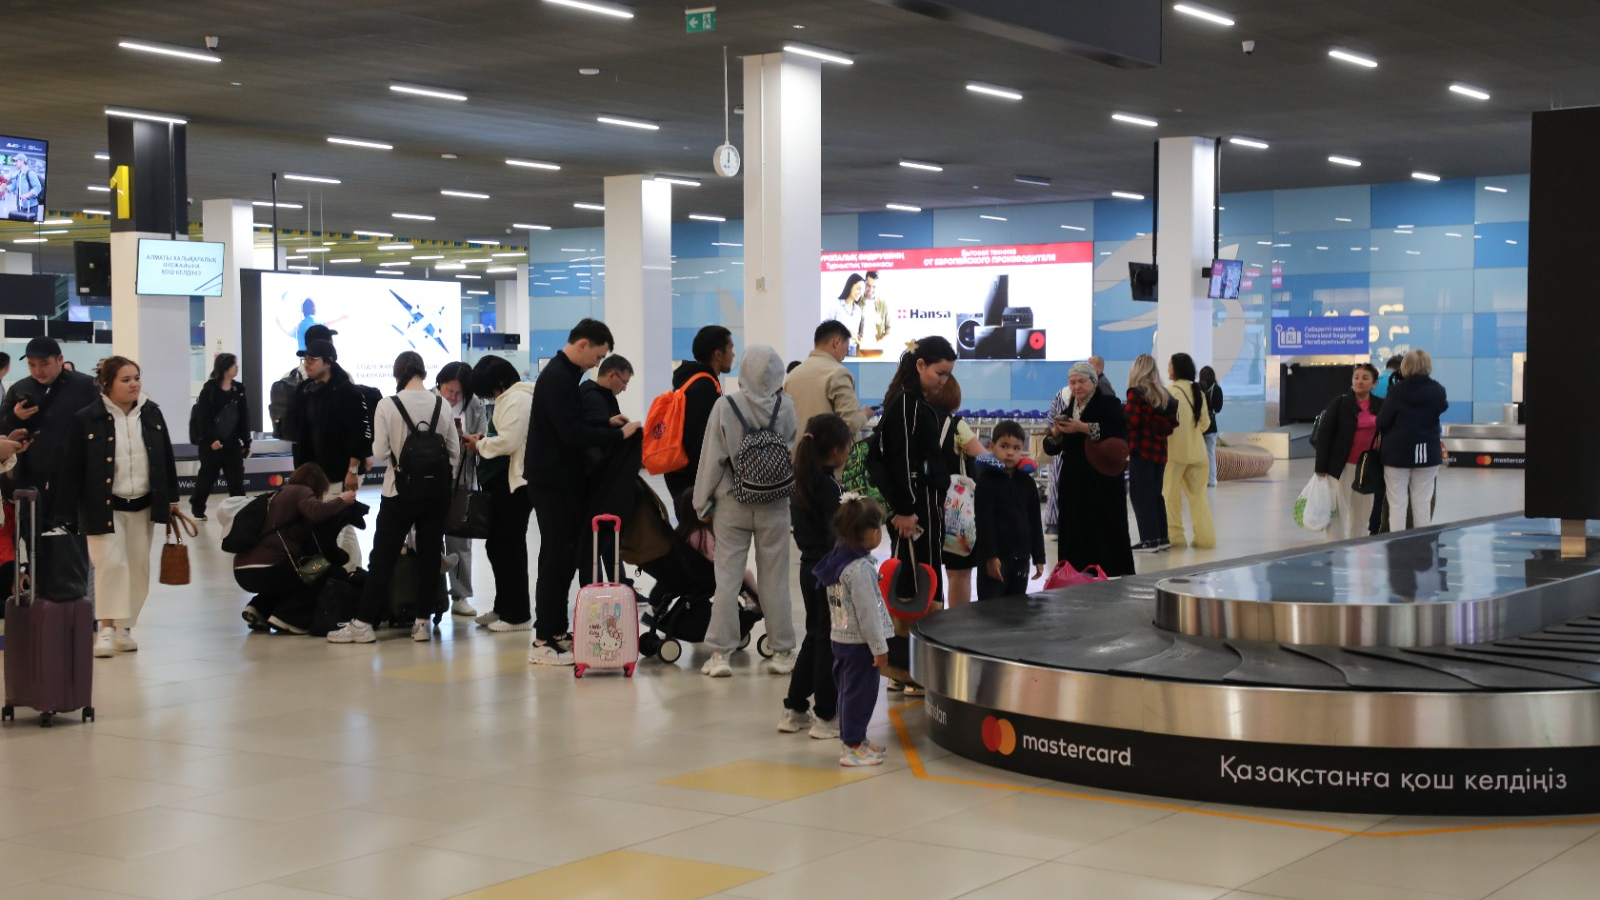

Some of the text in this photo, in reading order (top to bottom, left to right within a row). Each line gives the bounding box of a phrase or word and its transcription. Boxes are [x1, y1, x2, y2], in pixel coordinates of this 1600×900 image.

[110, 165, 129, 219] 1
[924, 254, 1056, 266] ОТ ЕВРОПЕЙСКОГО ПРОИЗВОДИТЕЛЯ
[961, 249, 989, 257] Бытовая
[910, 309, 951, 319] Hansa
[1022, 734, 1132, 767] mastercard
[1220, 755, 1568, 794] Қазақстанға қош келдіңіз
